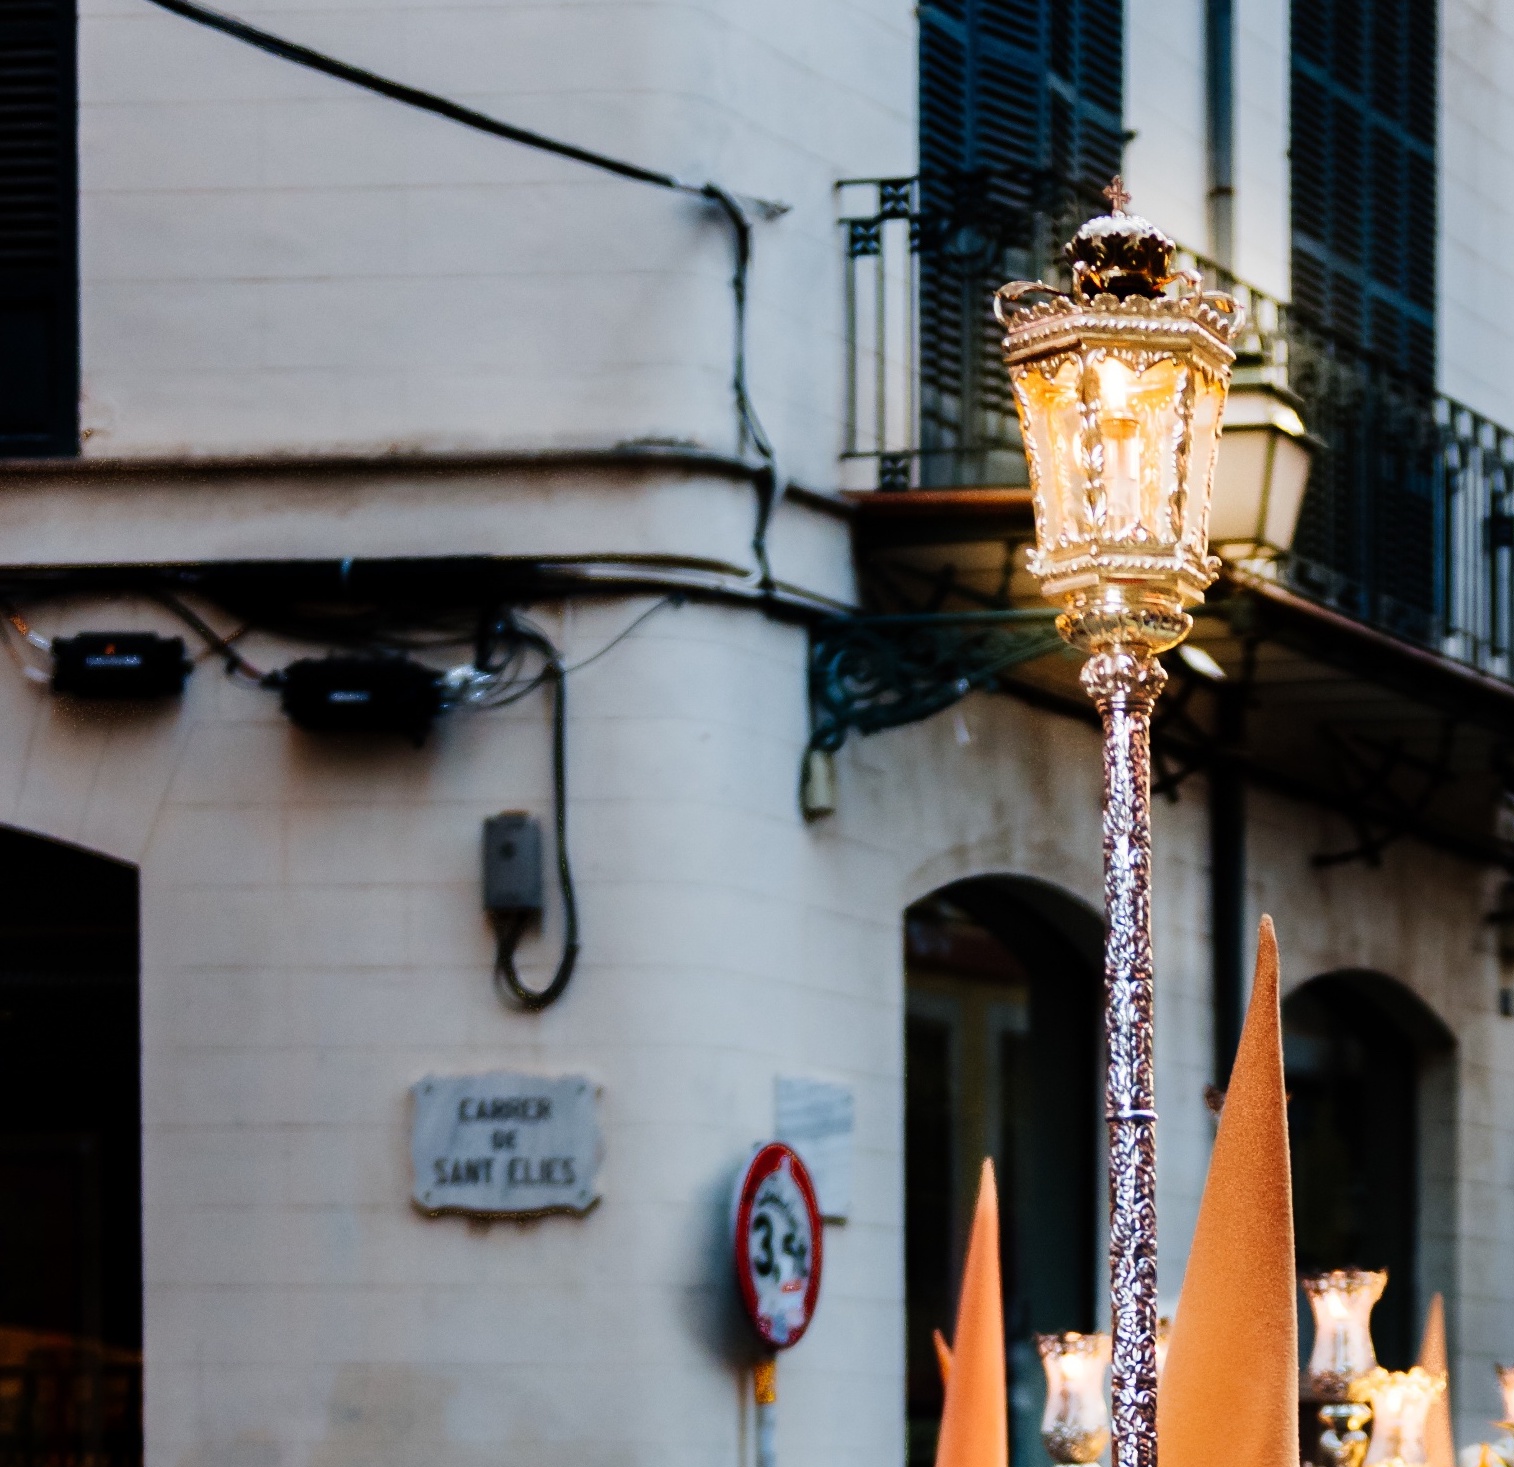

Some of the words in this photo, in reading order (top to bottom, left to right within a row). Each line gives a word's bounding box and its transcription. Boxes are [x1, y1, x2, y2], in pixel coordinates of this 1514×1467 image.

[458, 1097, 552, 1124] CARRER
[491, 1128, 517, 1152] DE
[433, 1157, 495, 1187] SANT
[507, 1156, 576, 1188] ELIES
